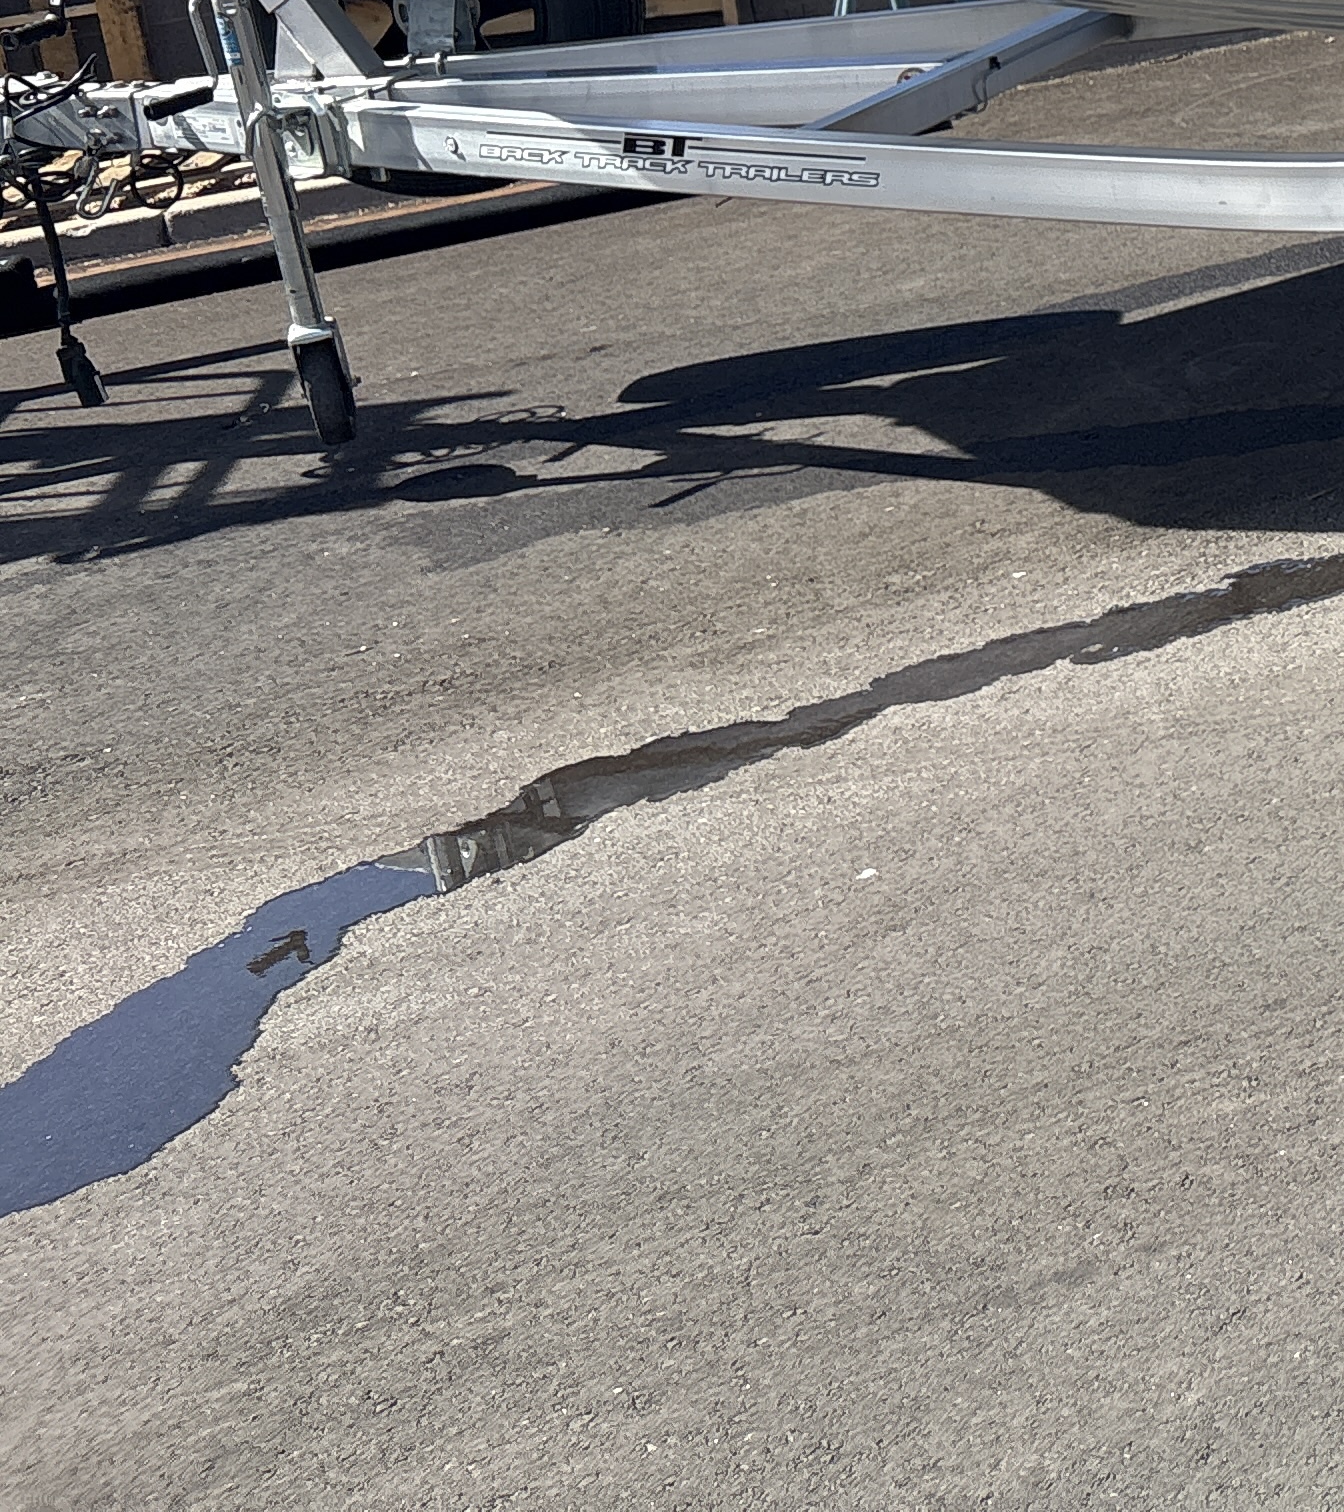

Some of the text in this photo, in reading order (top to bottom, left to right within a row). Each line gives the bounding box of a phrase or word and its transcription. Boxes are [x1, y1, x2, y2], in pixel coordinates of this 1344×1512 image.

[623, 132, 703, 157] BT
[480, 144, 880, 187] BACK TRACK TRAILERS
